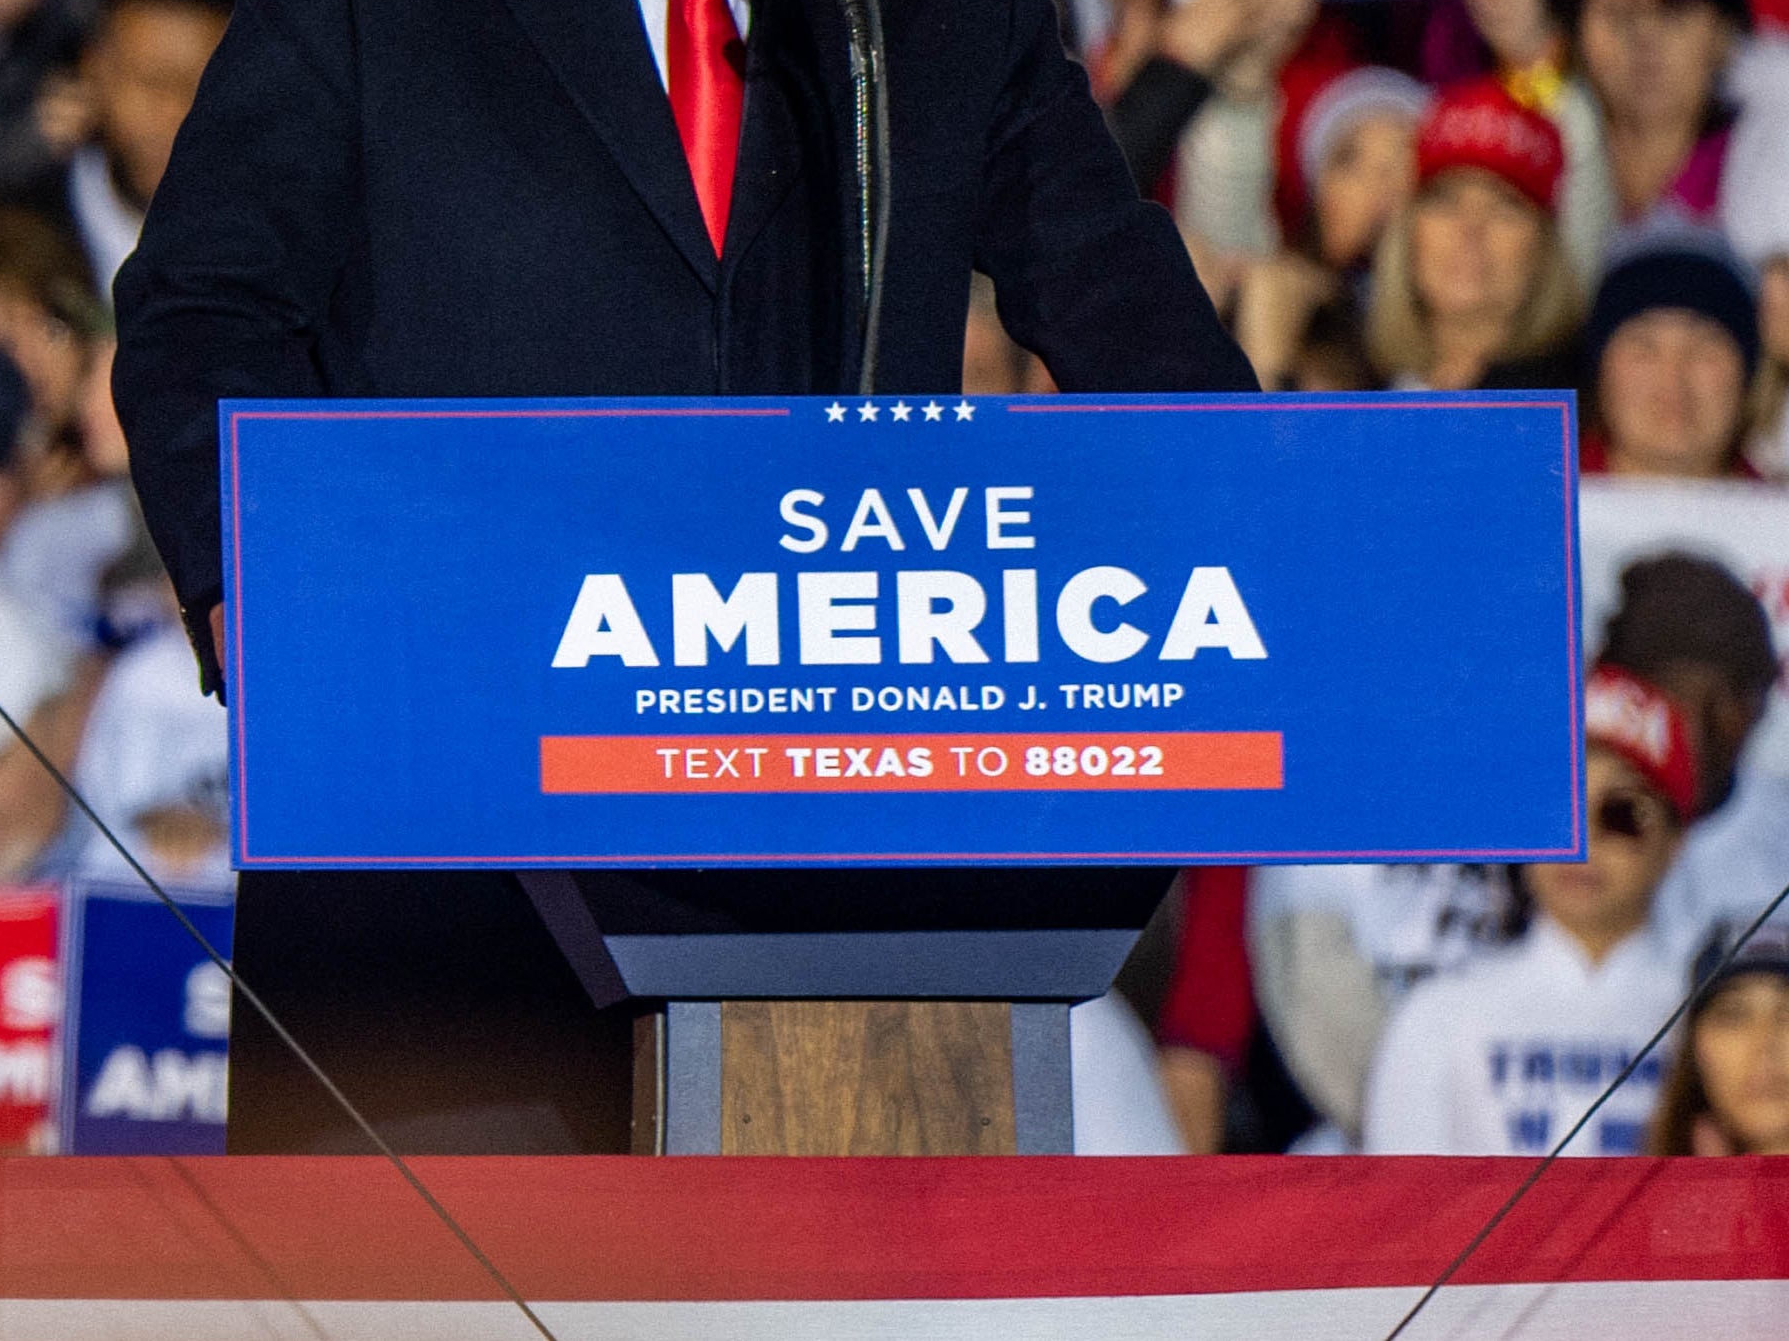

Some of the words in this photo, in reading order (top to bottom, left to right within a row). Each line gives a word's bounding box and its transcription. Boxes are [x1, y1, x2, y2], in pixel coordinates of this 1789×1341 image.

[779, 486, 1035, 554] SAVE
[551, 565, 1268, 668] AMERICA
[635, 687, 838, 715] PRESIDENT
[851, 685, 1007, 712] DONALD
[1018, 685, 1048, 711] J.
[1059, 683, 1185, 709] TRUMP
[655, 747, 770, 779] TEXT
[784, 746, 935, 778] TEXAS
[948, 746, 1009, 777] TO
[1023, 745, 1165, 777] 88022
